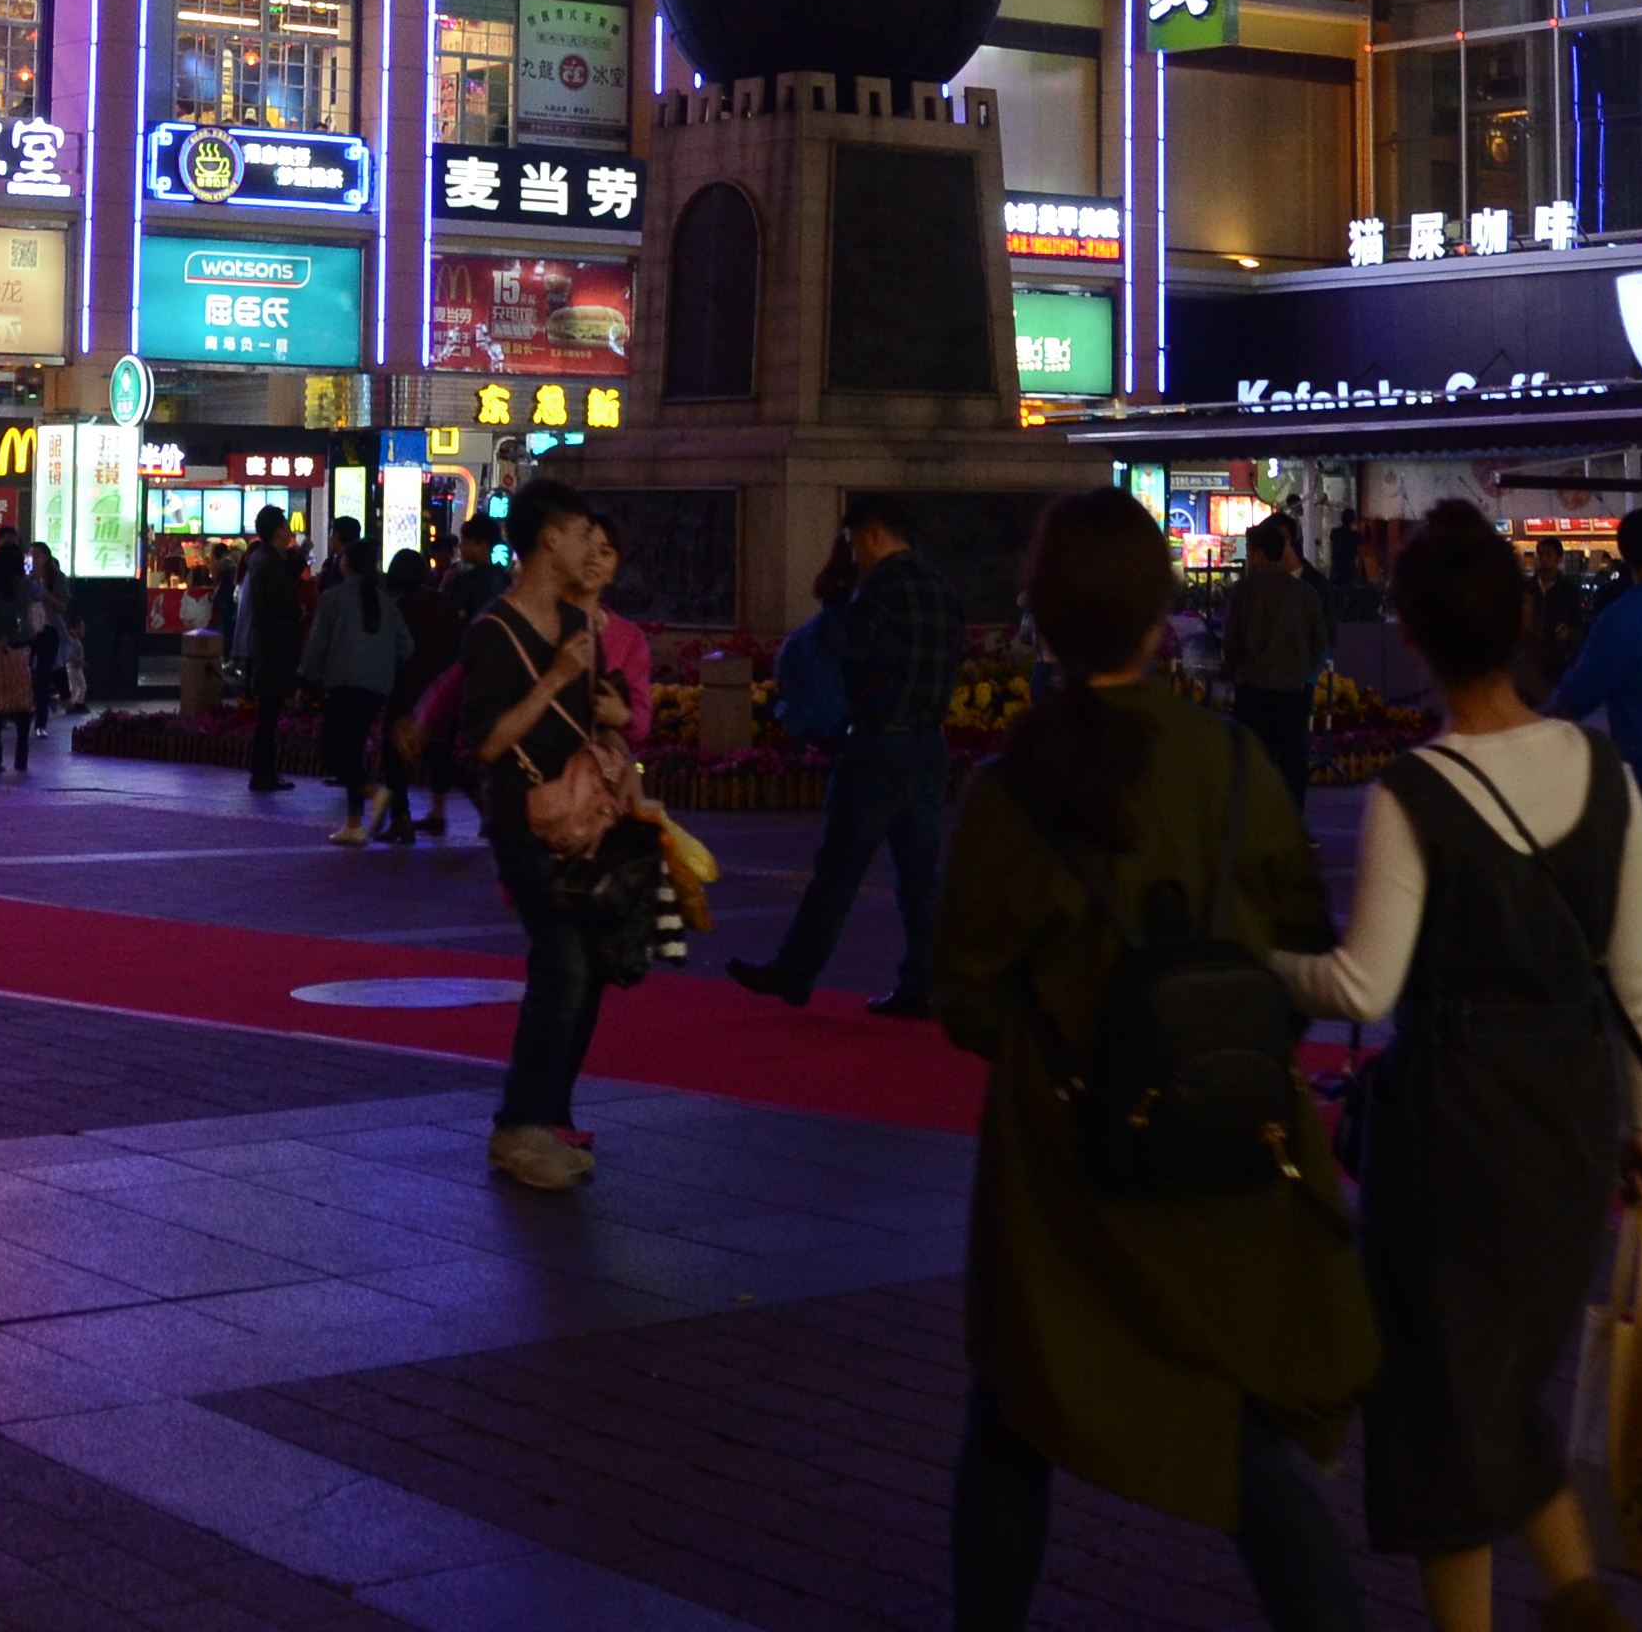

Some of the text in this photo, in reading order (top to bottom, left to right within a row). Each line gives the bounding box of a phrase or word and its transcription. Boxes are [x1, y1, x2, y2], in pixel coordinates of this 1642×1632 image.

[444, 156, 638, 219] 麦当劳
[1348, 201, 1579, 267] 猫屎咖啡
[201, 258, 294, 280] watsons
[492, 270, 521, 305] 15
[204, 293, 290, 329] 屈臣氏
[434, 307, 472, 324] 麦当劳
[204, 335, 289, 354] 商场负一层
[478, 383, 621, 429] 东急新
[140, 442, 185, 475] 半价
[245, 455, 314, 478] 麦当劳
